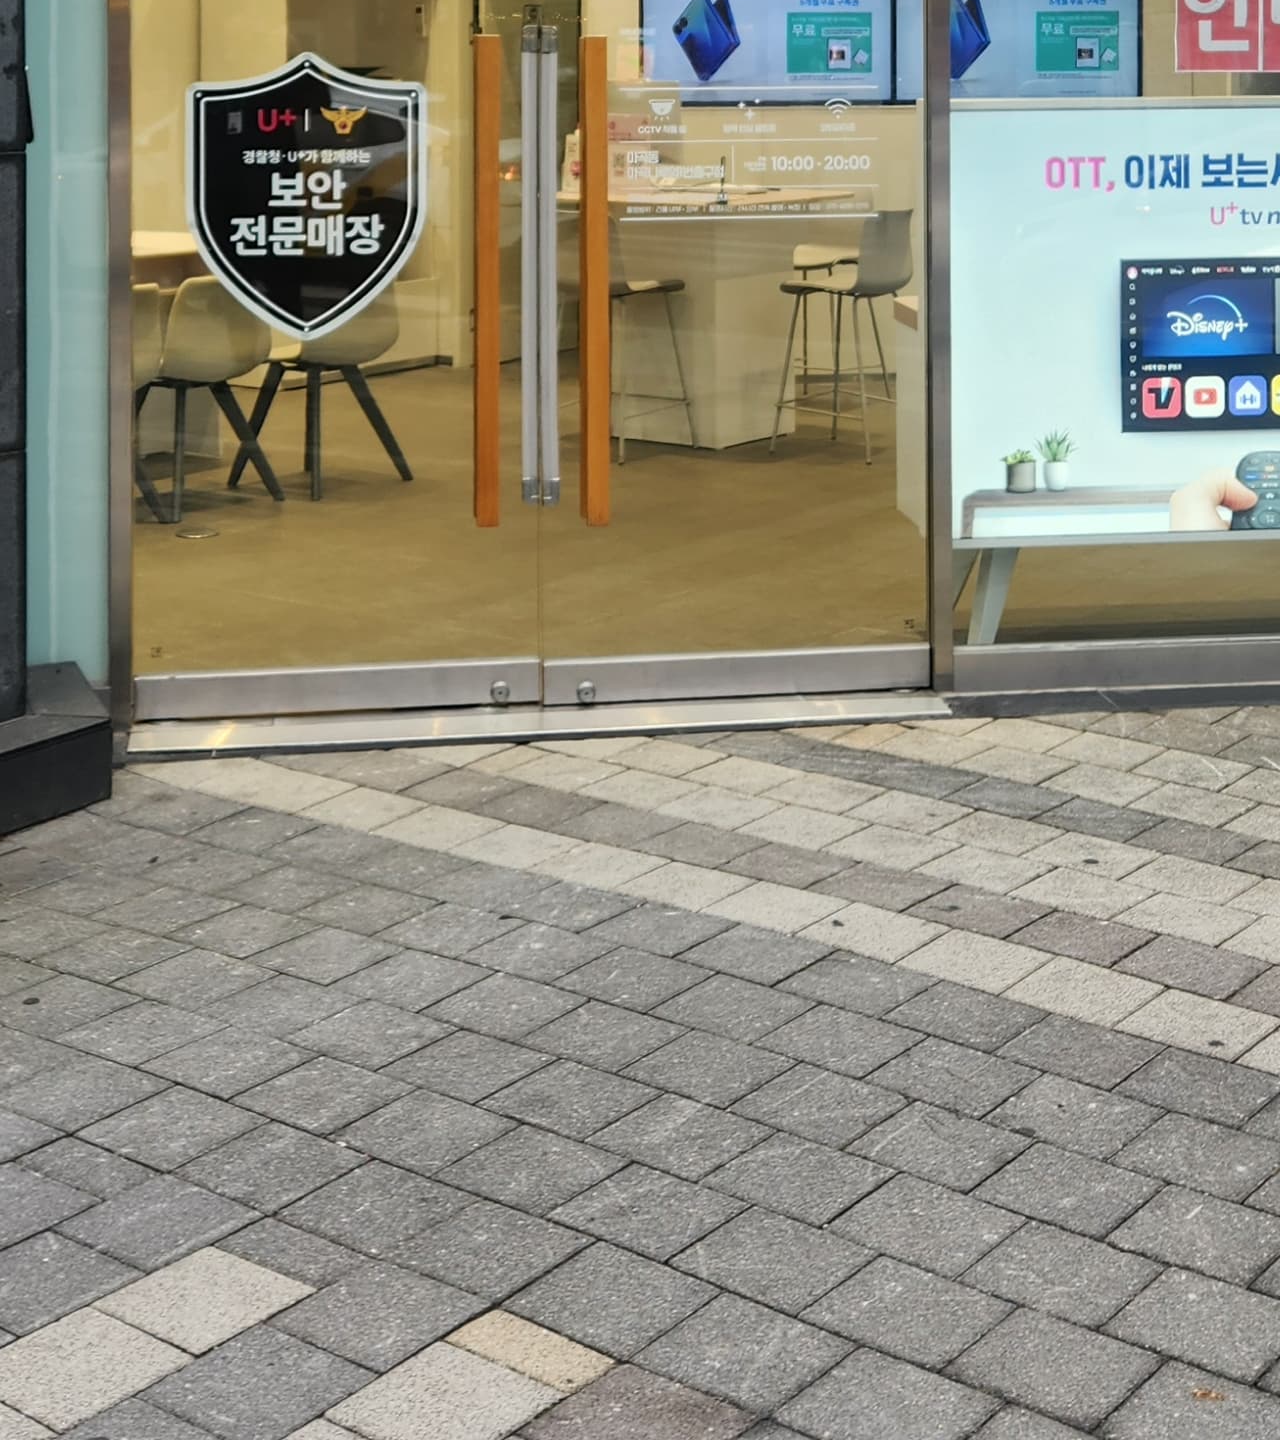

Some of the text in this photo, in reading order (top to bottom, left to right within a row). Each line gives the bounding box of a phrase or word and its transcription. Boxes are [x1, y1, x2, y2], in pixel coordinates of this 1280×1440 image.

[791, 23, 817, 38] 무료
[1040, 23, 1065, 36] 무료
[257, 109, 297, 133] U+
[320, 149, 372, 164] 함께하는
[771, 156, 814, 172] 10:00
[823, 155, 871, 172] 20:00
[1045, 156, 1116, 192] OTT,
[1124, 153, 1191, 190] 이제
[268, 169, 348, 210] 보안
[229, 213, 386, 257] 전문매장
